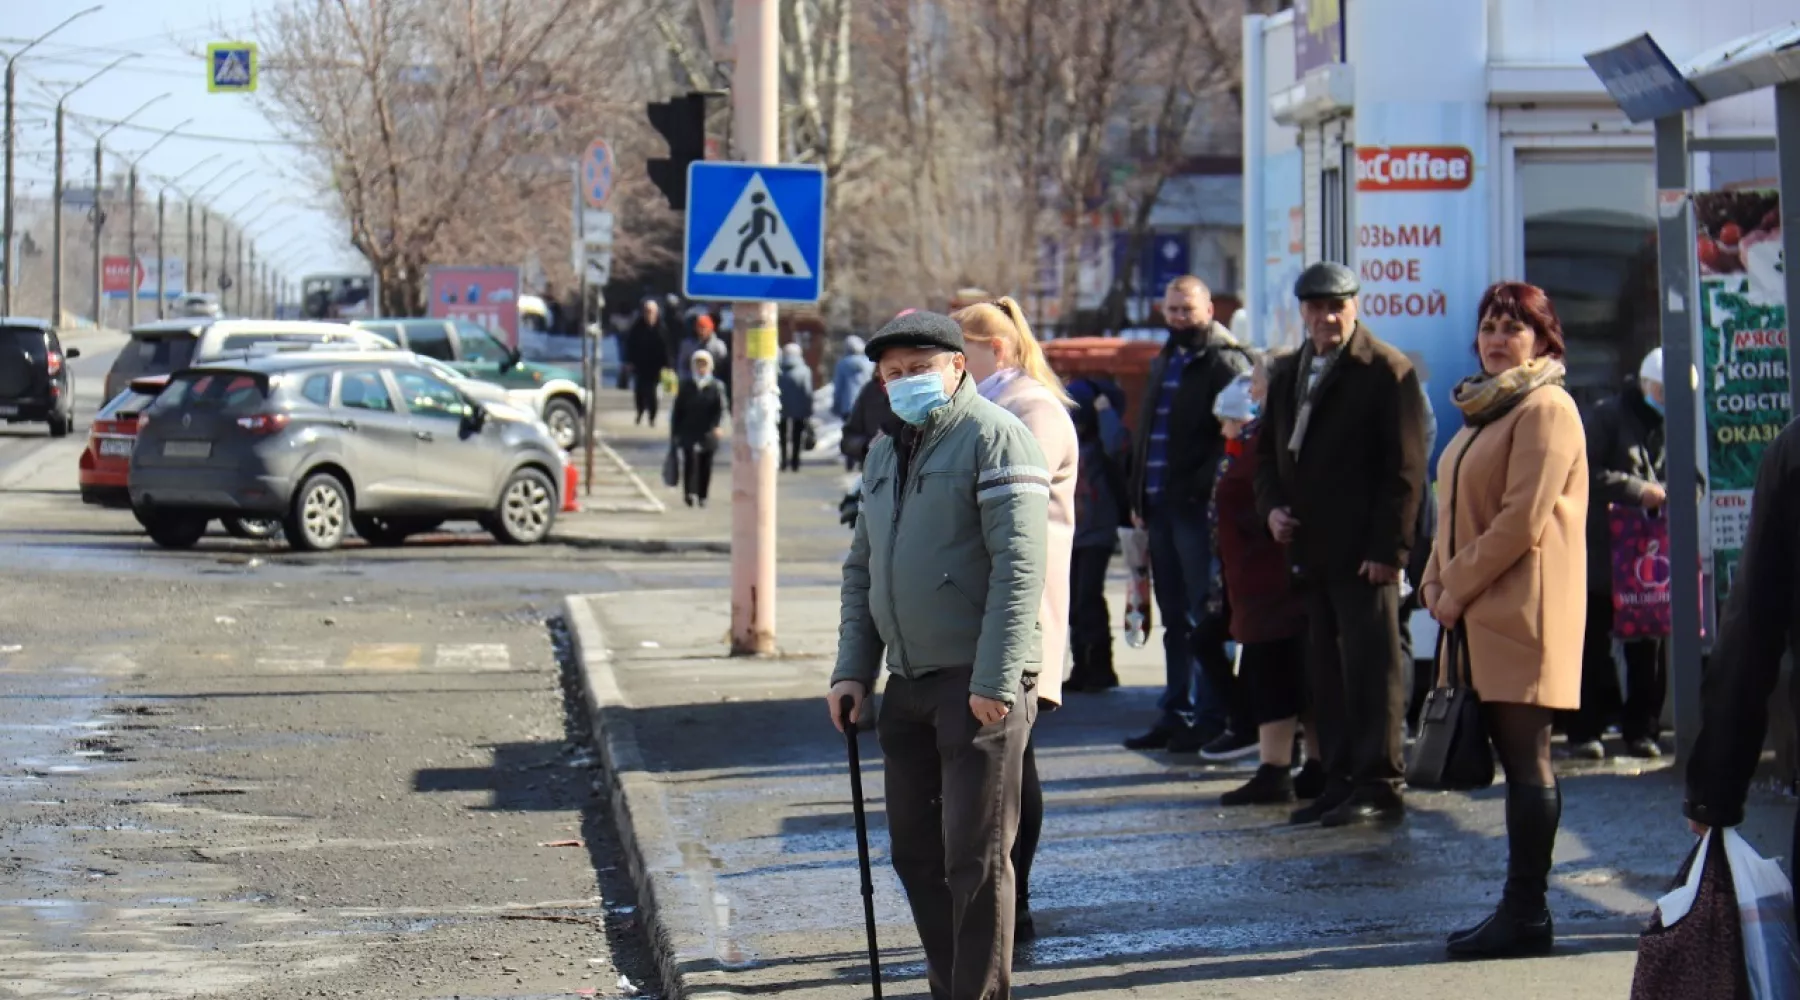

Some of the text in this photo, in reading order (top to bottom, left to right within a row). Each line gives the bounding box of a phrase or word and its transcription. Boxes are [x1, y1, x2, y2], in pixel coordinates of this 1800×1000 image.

[1356, 152, 1467, 184] acCoffee
[1357, 224, 1441, 247] ОЗЬМИ
[1360, 258, 1421, 282] КОФЕ
[1363, 288, 1447, 317] СОБОЙ
[1727, 361, 1790, 379] КОЛБ
